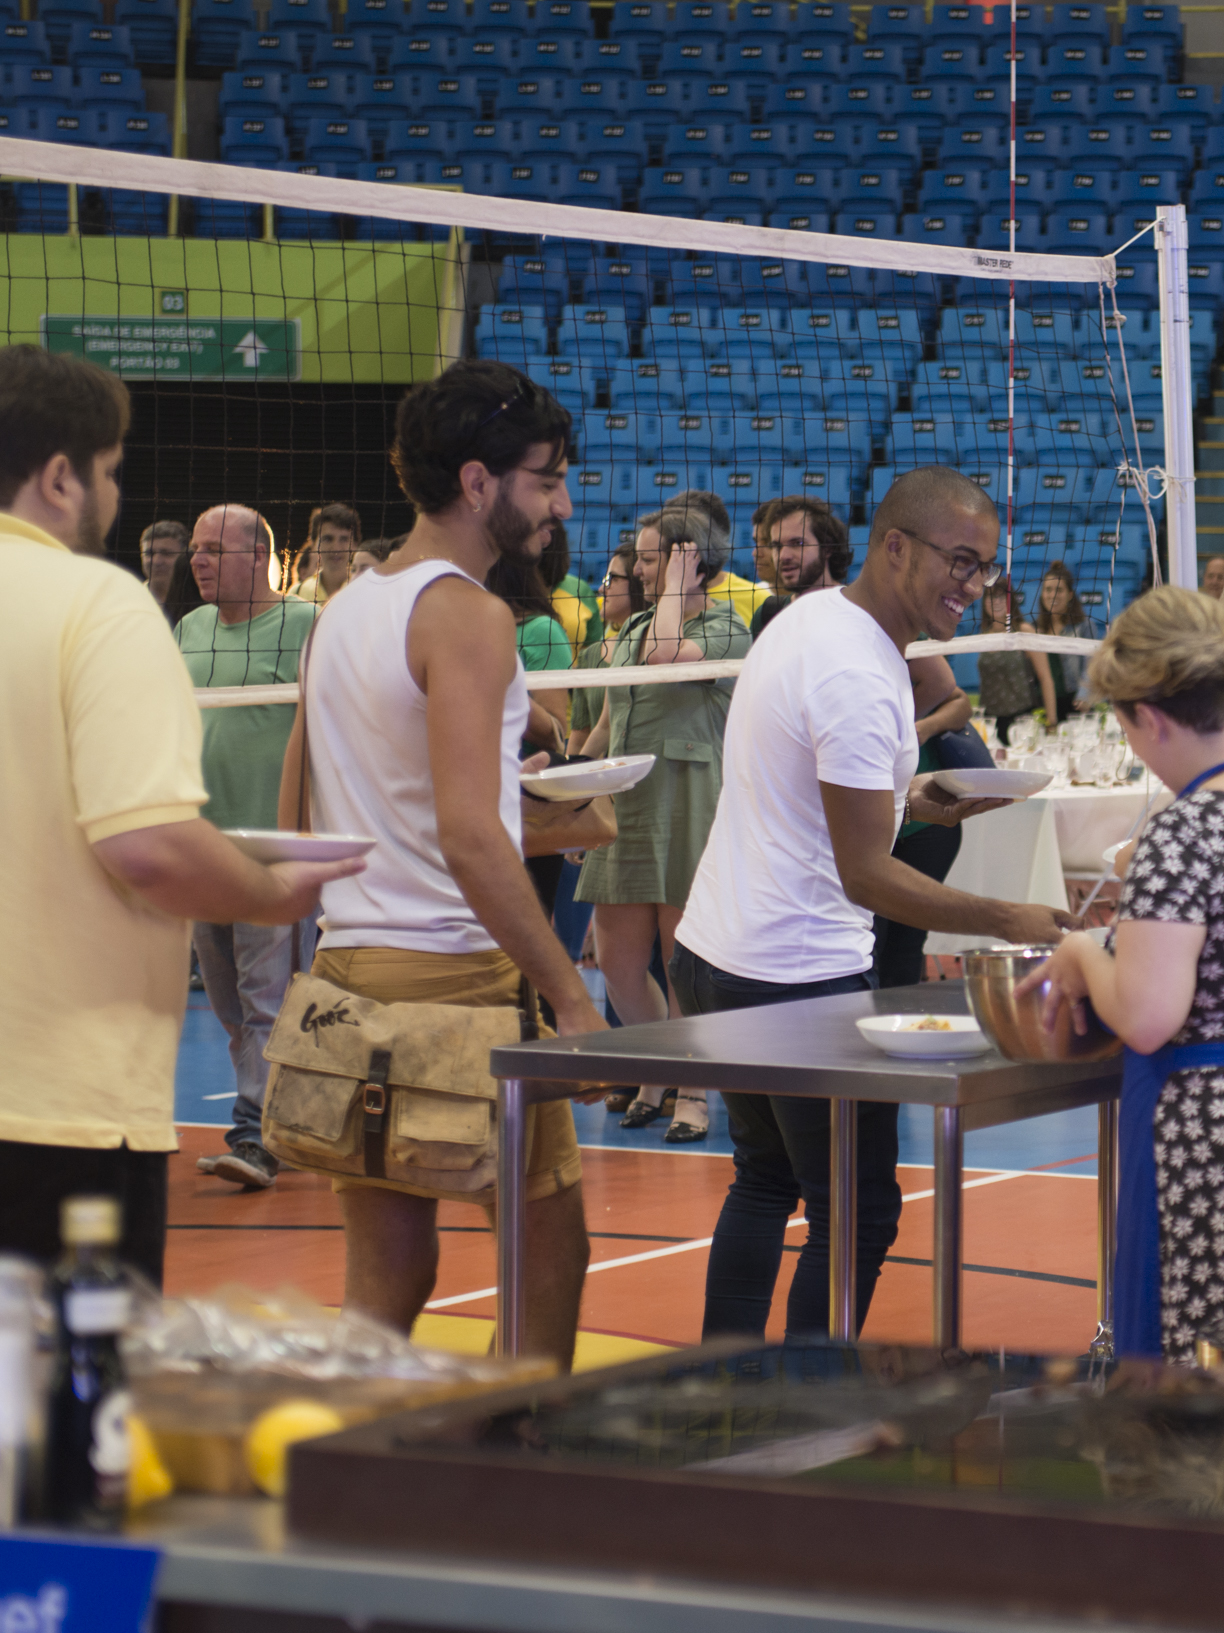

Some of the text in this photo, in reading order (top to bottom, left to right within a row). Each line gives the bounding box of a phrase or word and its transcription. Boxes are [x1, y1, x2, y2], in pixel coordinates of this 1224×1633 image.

[162, 294, 184, 310] 03
[113, 325, 131, 338] DE
[133, 324, 216, 339] EMERGÊNCIA
